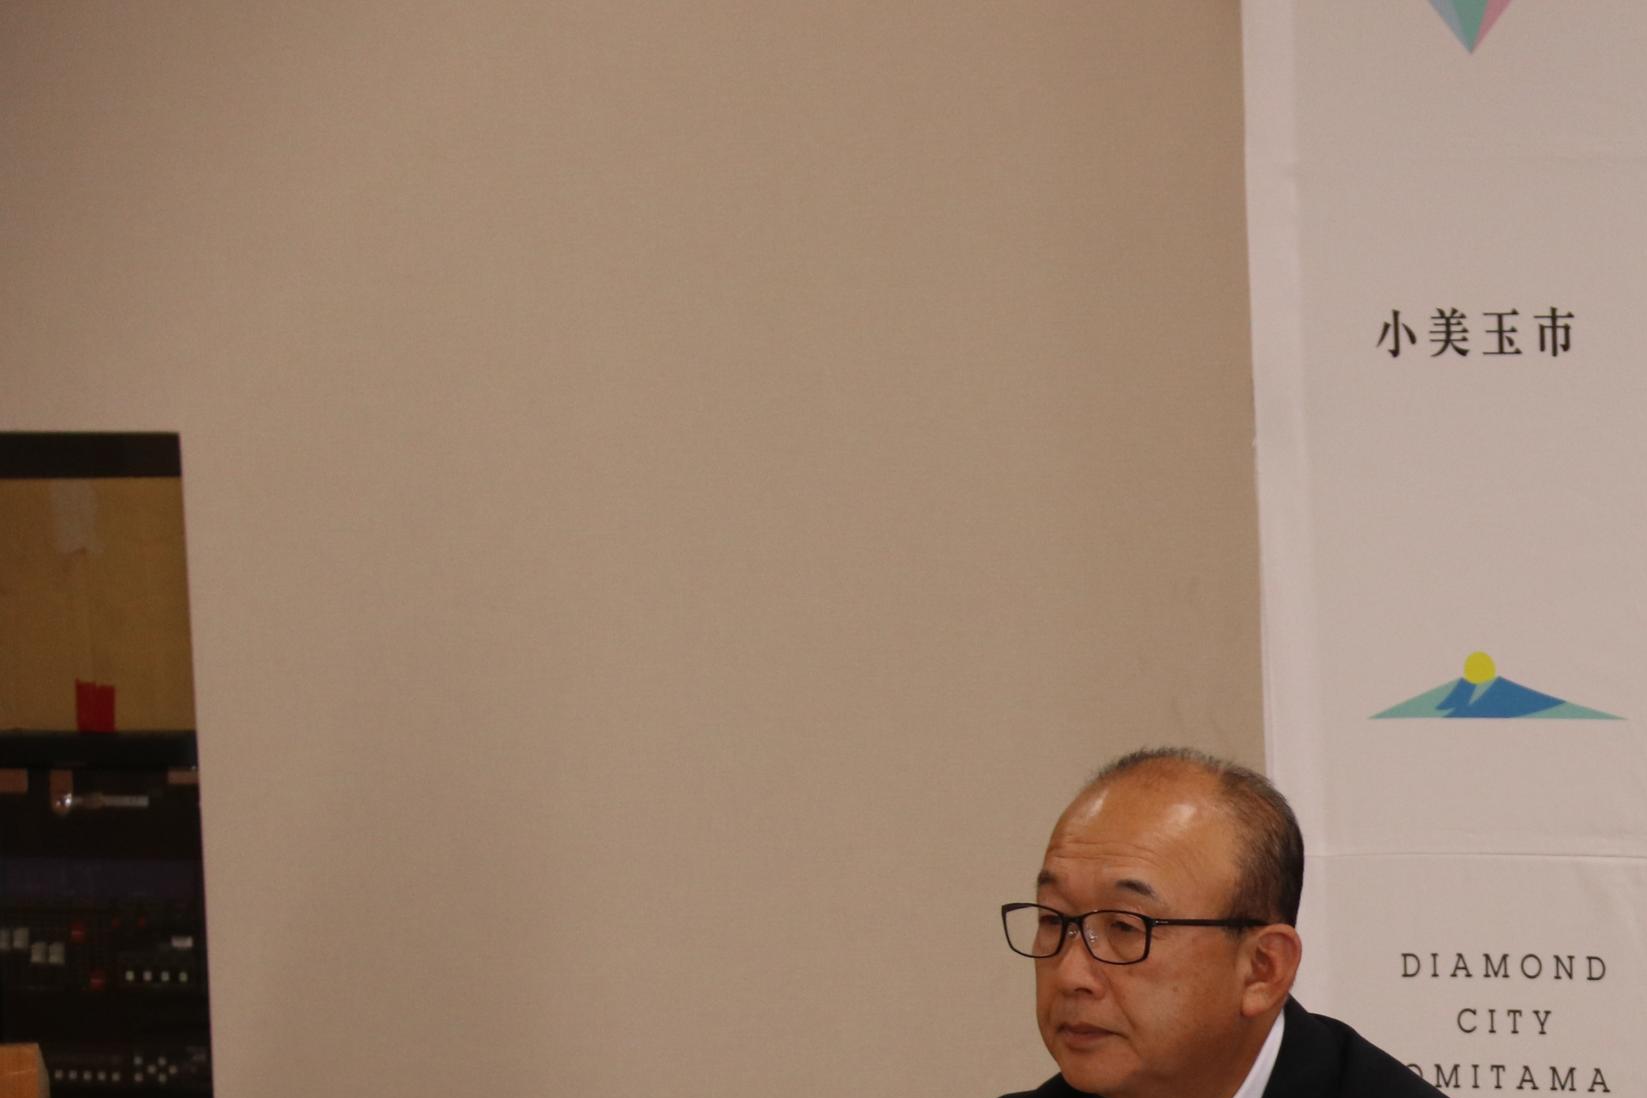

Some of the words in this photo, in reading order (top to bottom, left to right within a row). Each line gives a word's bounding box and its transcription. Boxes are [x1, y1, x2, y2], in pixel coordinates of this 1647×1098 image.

[1378, 307, 1574, 358] 小美玉市
[1402, 953, 1606, 981] DIAMOND
[1457, 1008, 1551, 1035] CITY
